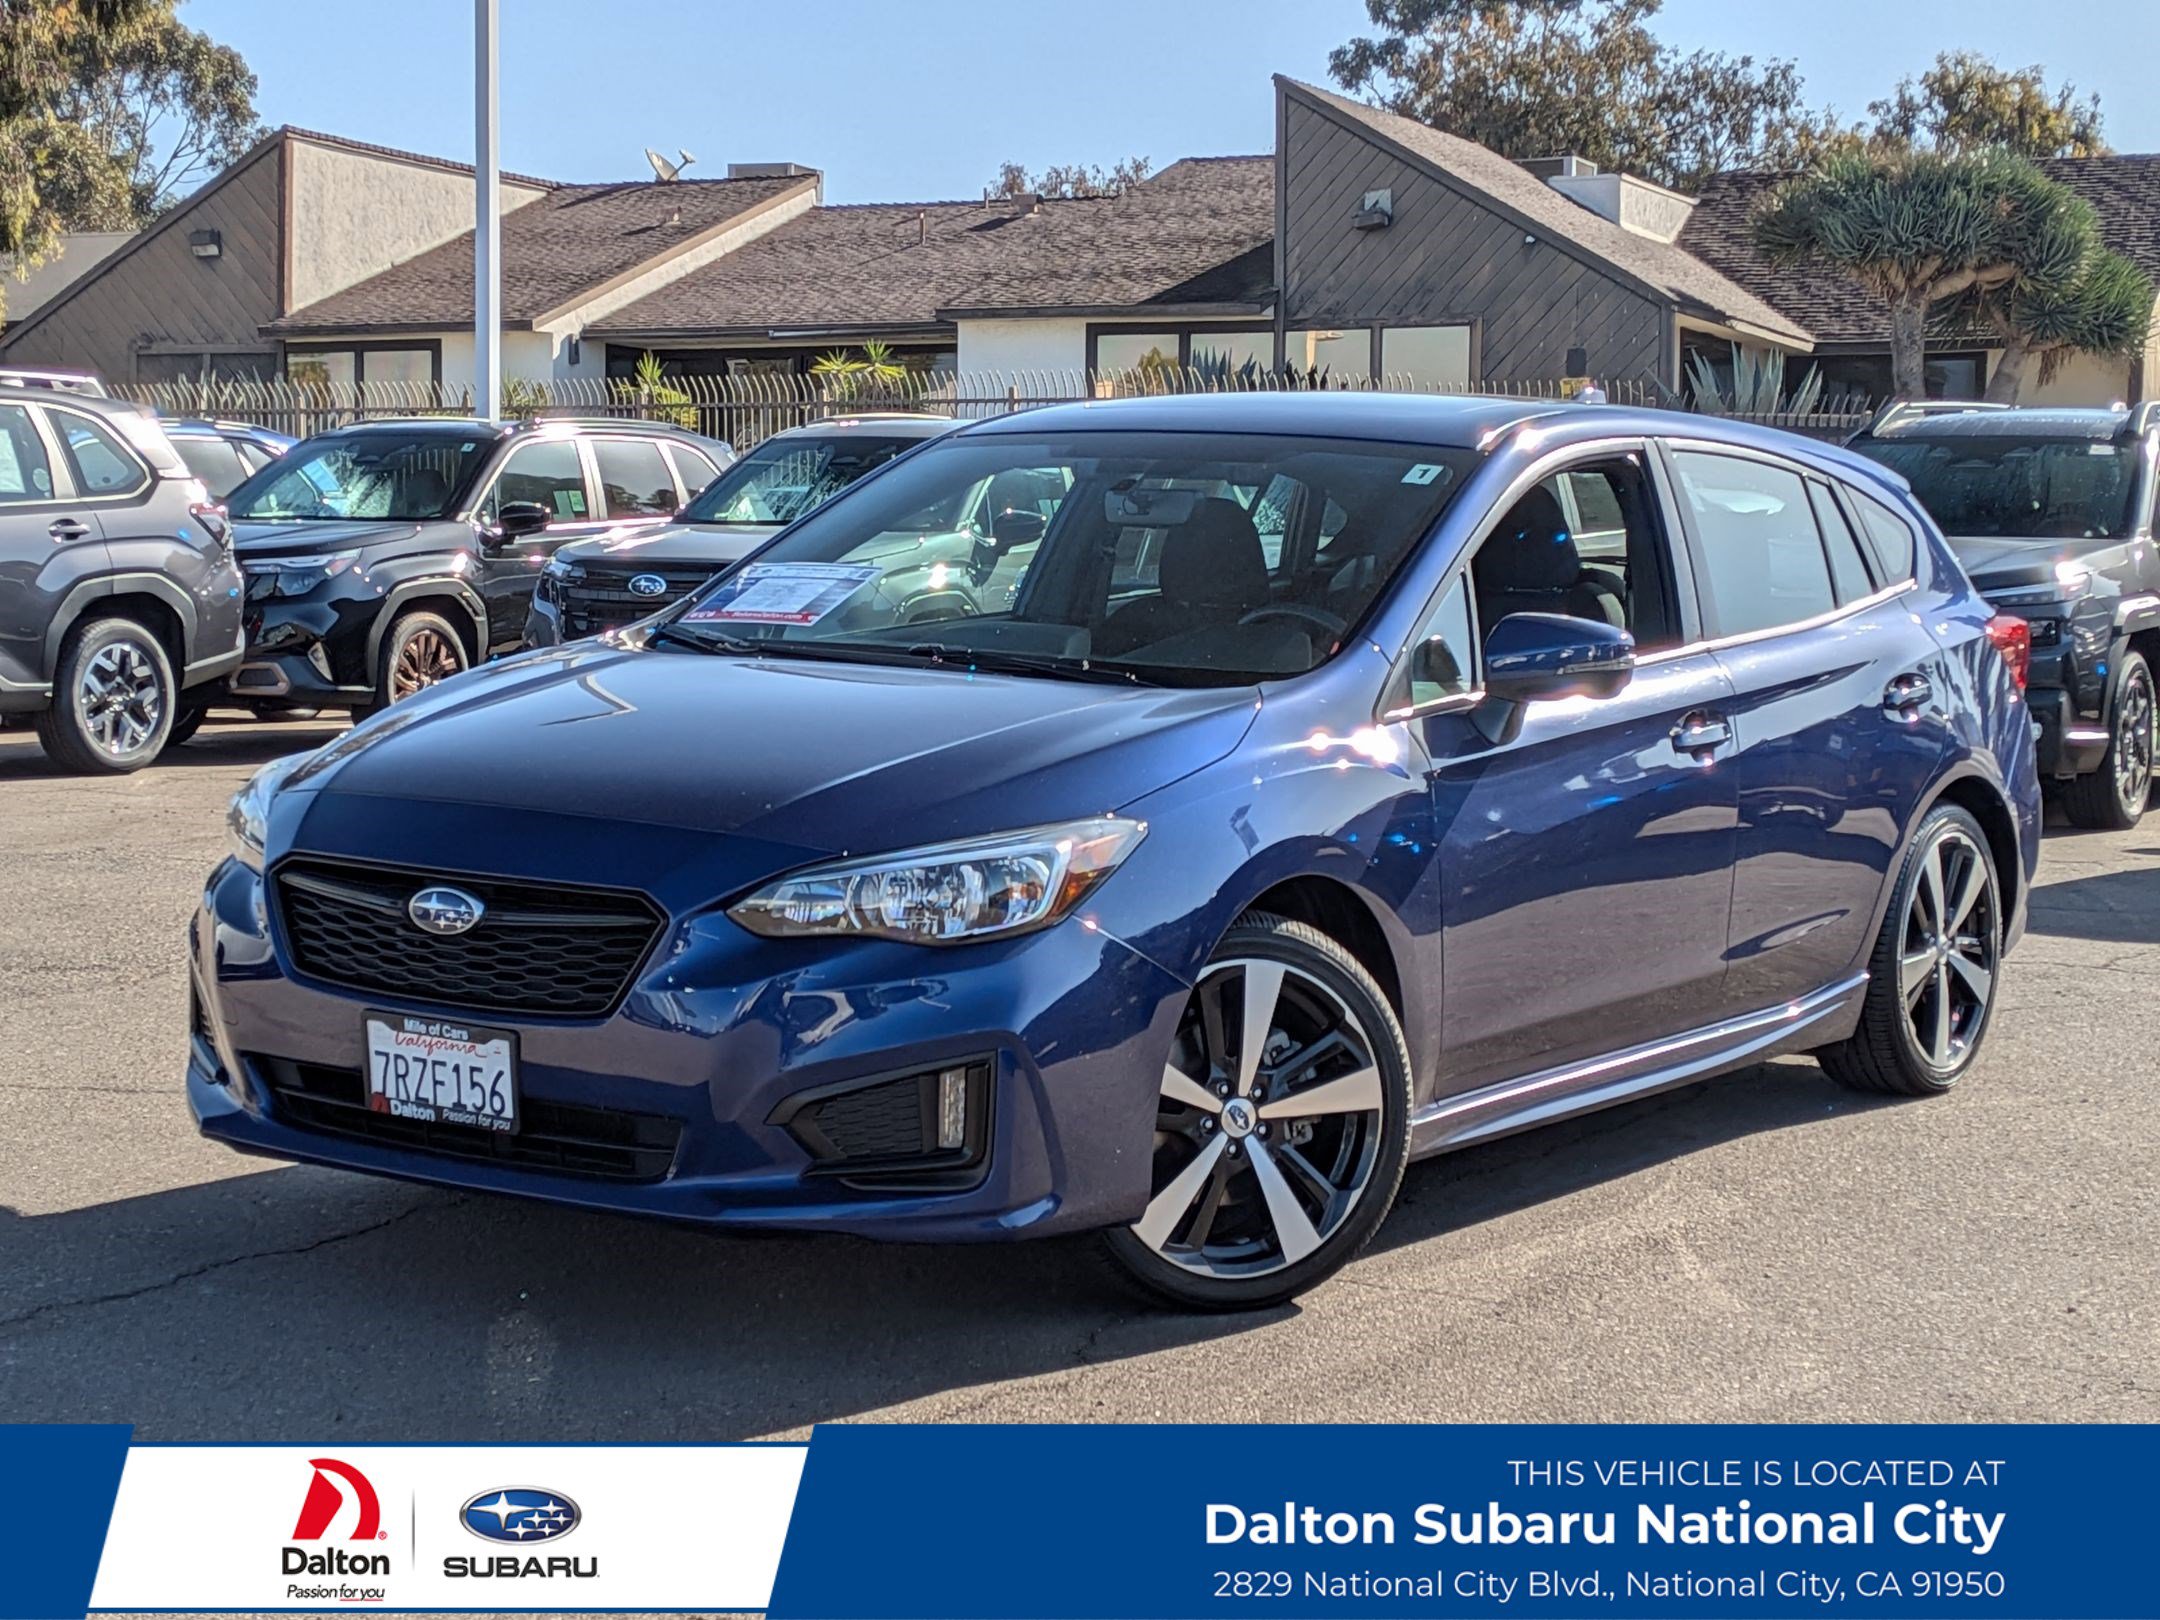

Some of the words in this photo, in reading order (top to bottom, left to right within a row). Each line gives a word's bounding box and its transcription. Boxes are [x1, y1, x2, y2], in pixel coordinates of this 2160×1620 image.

[404, 1018, 427, 1034] Mile
[428, 1023, 441, 1036] of
[442, 1025, 469, 1041] Cars
[374, 1051, 506, 1116] 7RZF156
[390, 1099, 436, 1122] Dalton
[442, 1108, 477, 1125] Passion
[478, 1115, 492, 1127] for
[492, 1119, 511, 1130] you
